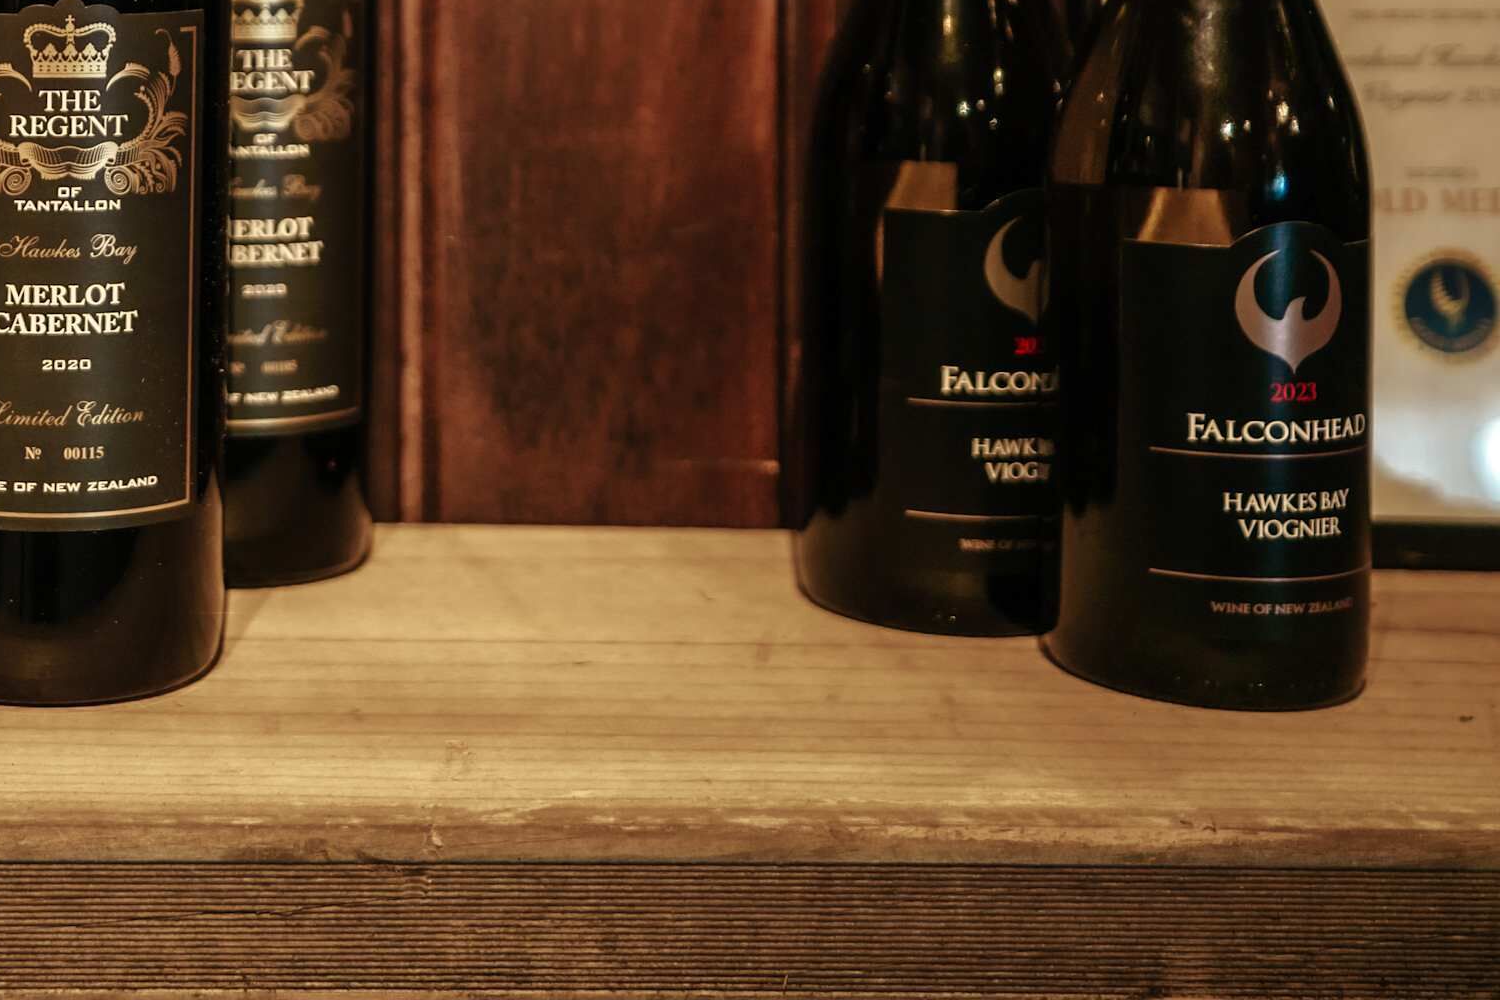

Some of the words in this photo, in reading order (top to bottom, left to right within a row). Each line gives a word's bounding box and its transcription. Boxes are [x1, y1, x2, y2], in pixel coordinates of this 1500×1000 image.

[236, 48, 292, 70] THE
[231, 69, 315, 93] EGENT
[38, 89, 102, 112] THE
[9, 114, 129, 138] REGENT
[57, 187, 82, 198] OF
[14, 199, 121, 212] TANTALLON
[231, 216, 314, 241] ERLOT
[90, 233, 137, 265] Bay
[230, 240, 324, 267] BERNET
[5, 282, 125, 307] MERLOT
[41, 359, 92, 371] 2020
[76, 401, 145, 428] Edition
[1186, 413, 1366, 443] FALCONHEAD
[63, 446, 105, 461] 00115
[13, 481, 37, 493] OF
[43, 481, 81, 493] NEW
[87, 475, 158, 492] ZEALAND
[1222, 491, 1317, 513] HAWKES
[1321, 488, 1350, 511] BAY
[1238, 516, 1342, 540] VIOGNIER
[1211, 600, 1251, 614] WINE
[1253, 602, 1274, 615] OF
[1275, 602, 1305, 615] NEW
